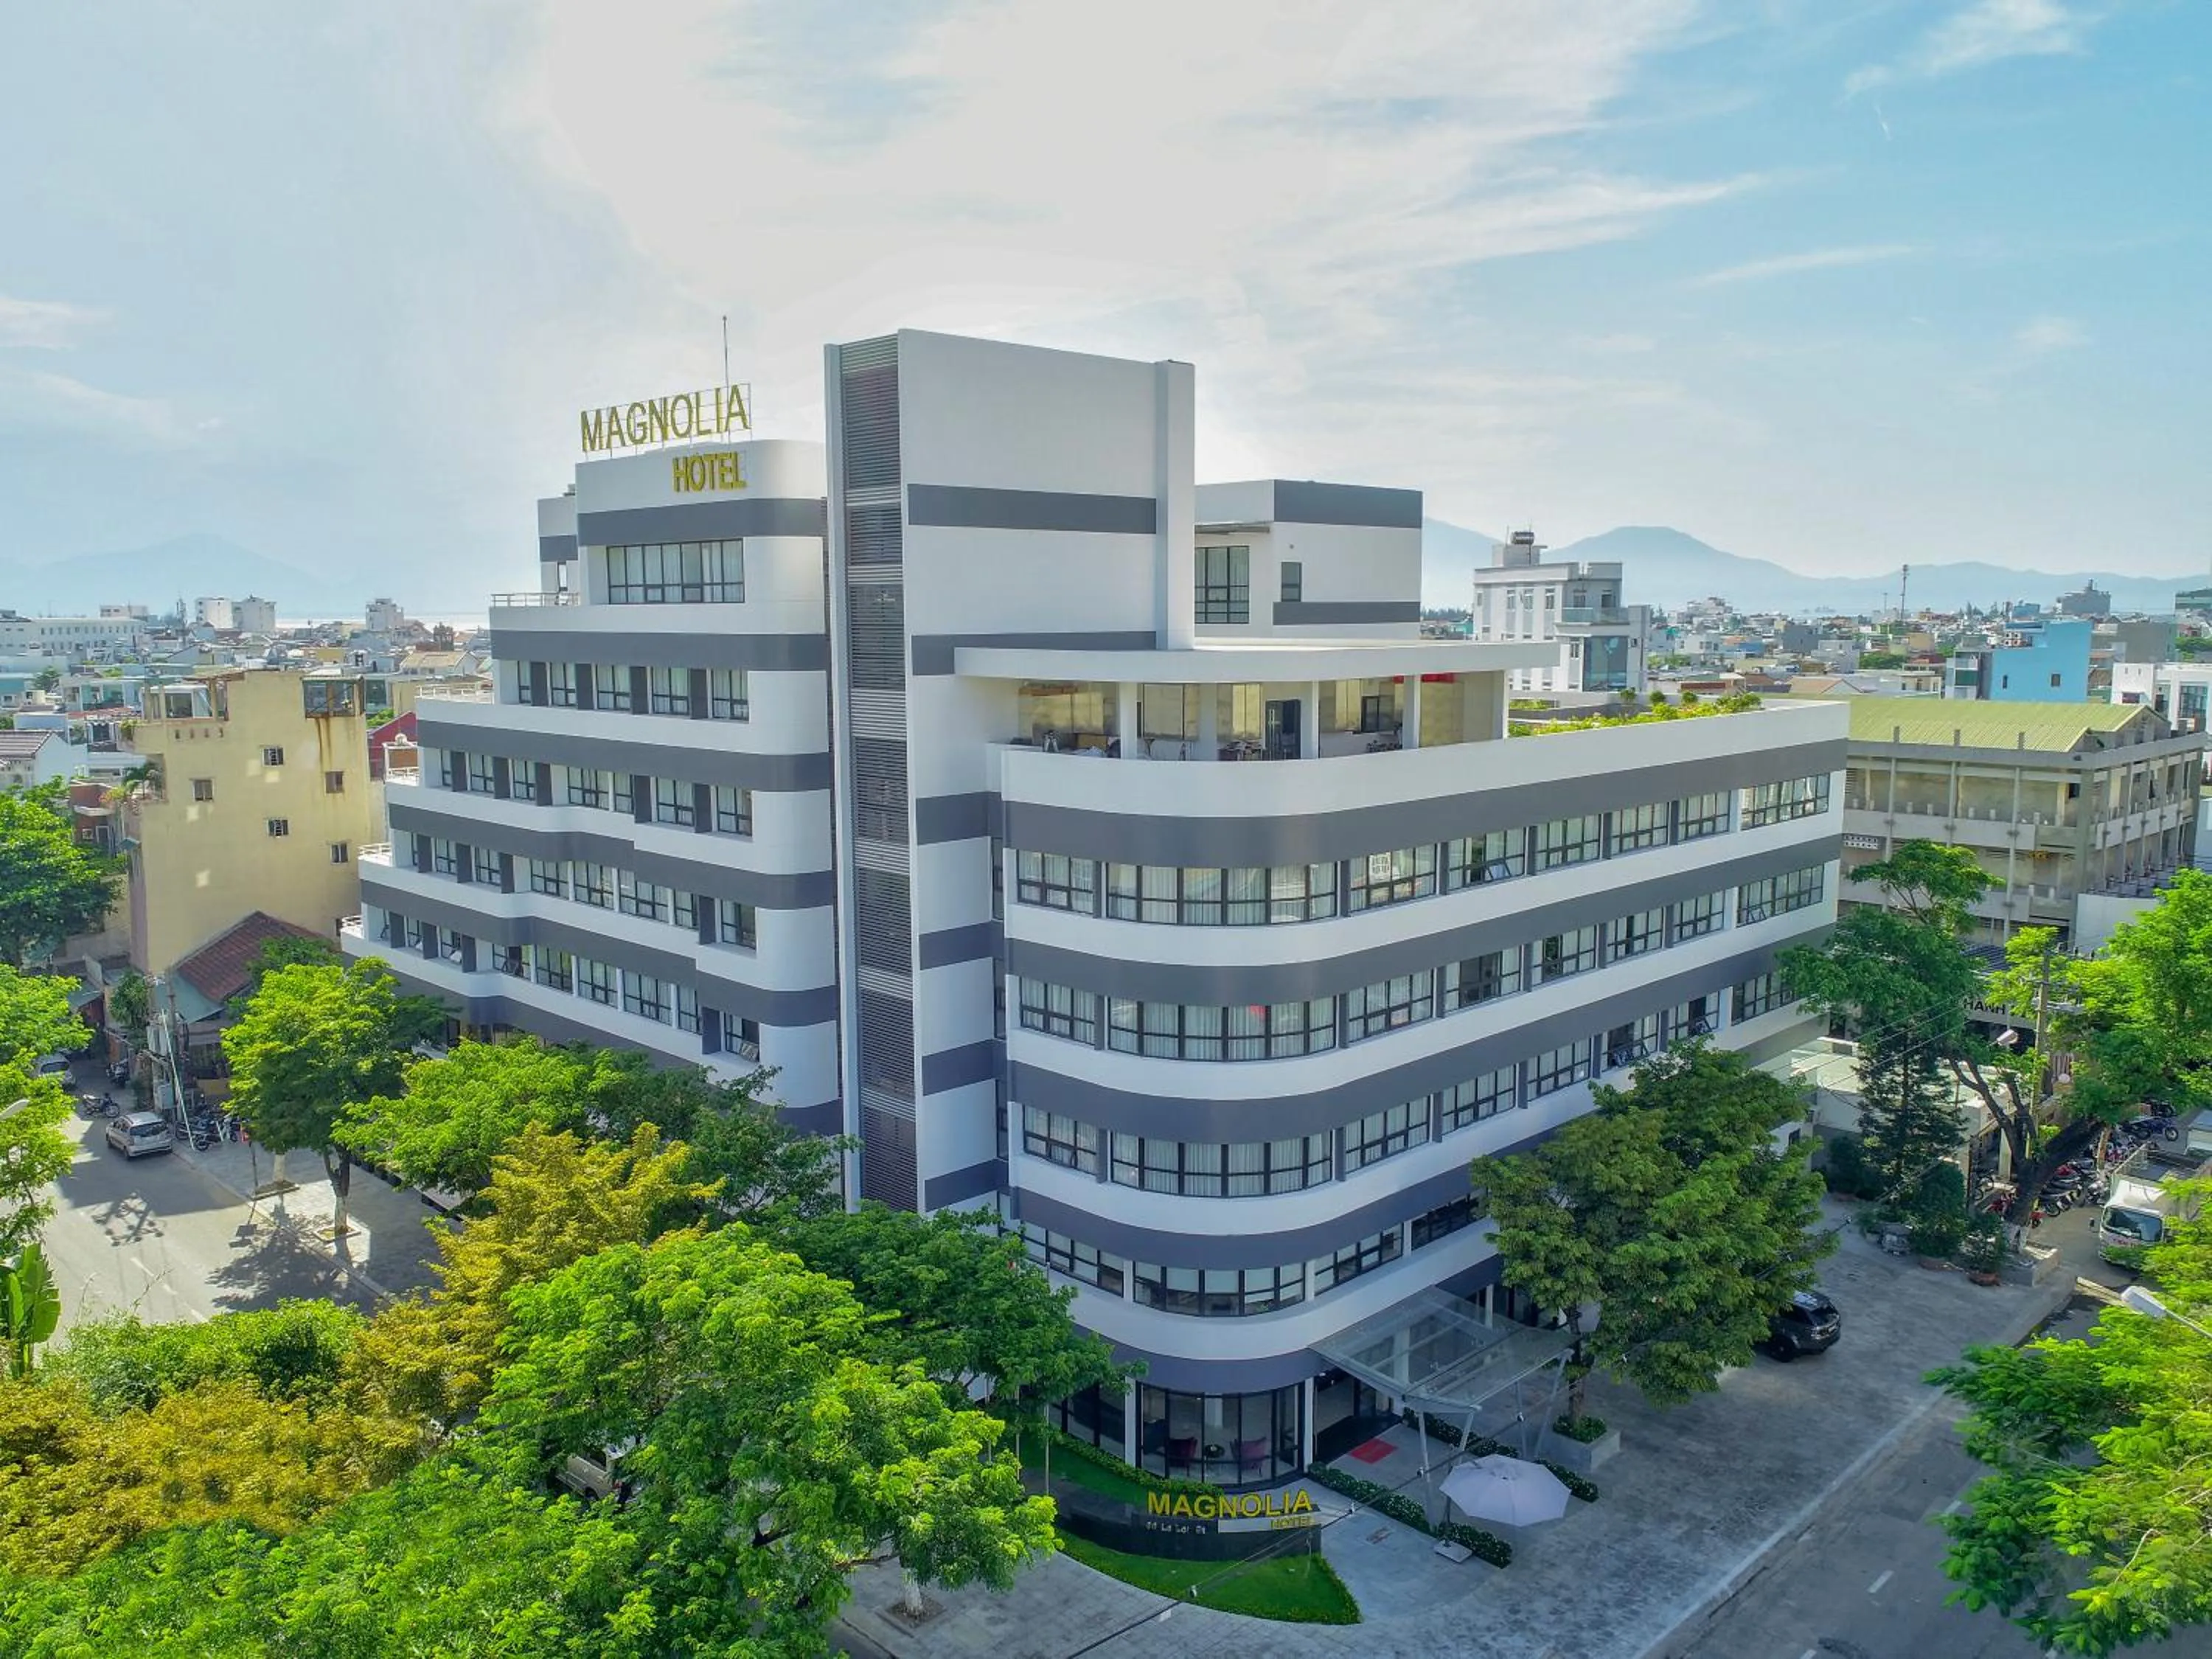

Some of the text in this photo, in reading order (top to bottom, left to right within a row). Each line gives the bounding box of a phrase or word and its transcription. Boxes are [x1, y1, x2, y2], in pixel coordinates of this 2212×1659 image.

[580, 384, 751, 452] MAGNOLIA
[672, 451, 747, 493] HOTEL
[1147, 1489, 1312, 1518] MAGNOLIA
[1270, 1514, 1315, 1529] HOTEL
